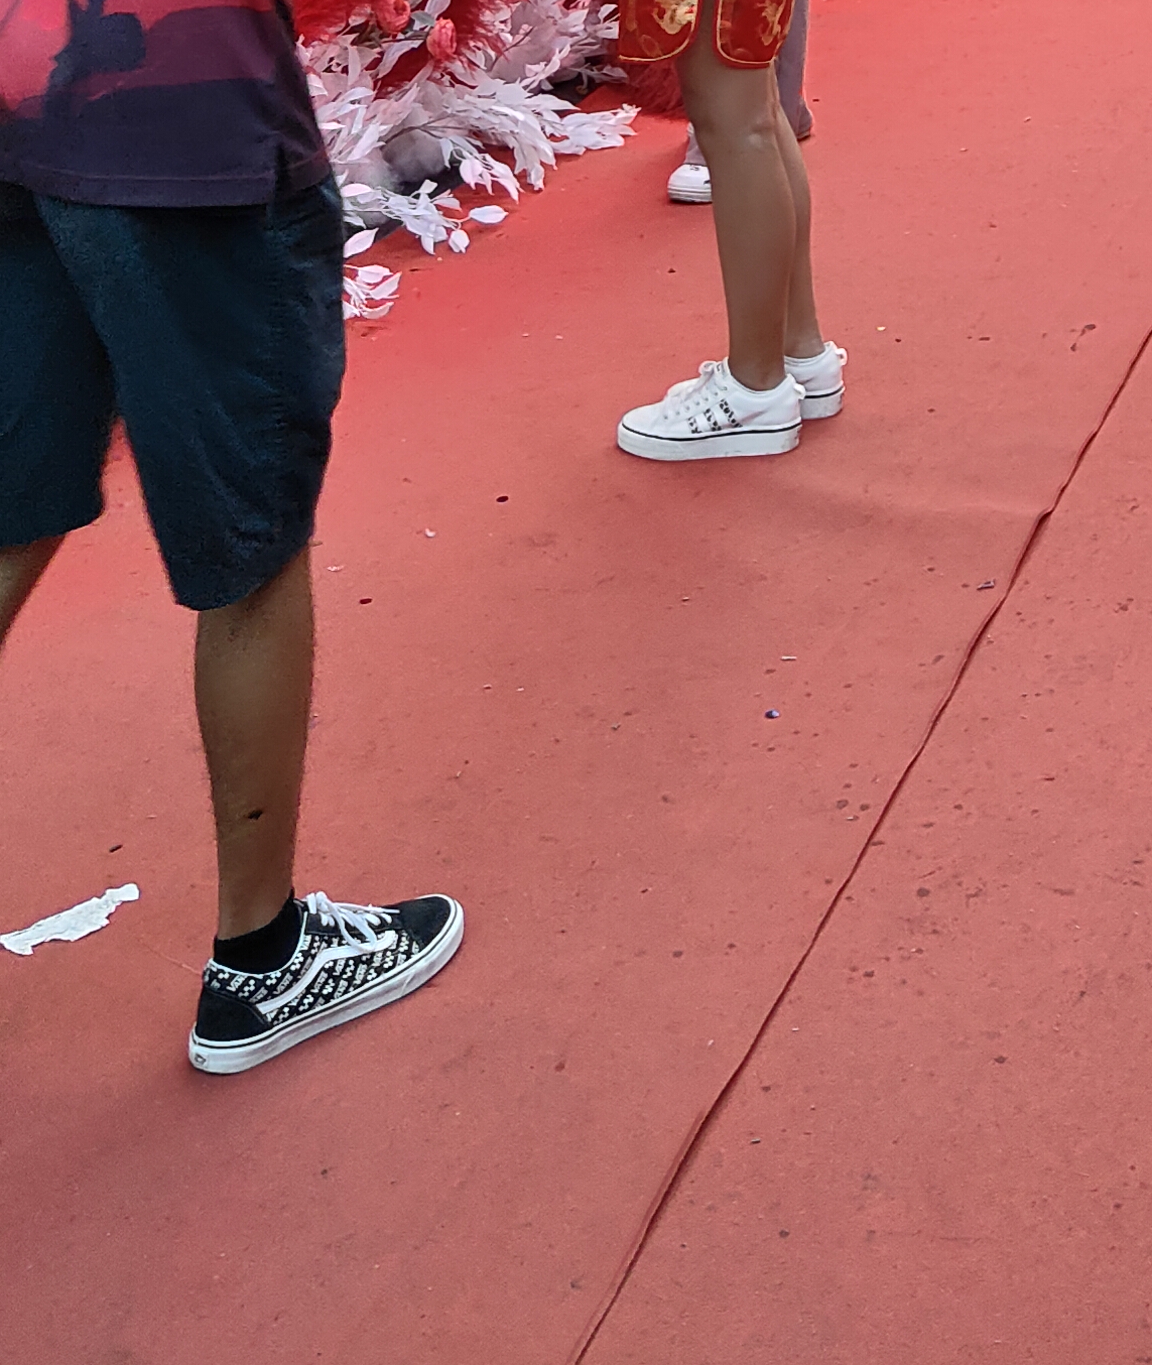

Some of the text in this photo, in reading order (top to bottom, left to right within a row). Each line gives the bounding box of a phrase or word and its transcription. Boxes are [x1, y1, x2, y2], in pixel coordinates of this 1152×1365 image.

[226, 973, 248, 993] VAN
[272, 972, 294, 995] VANS
[310, 971, 328, 993] VANS
